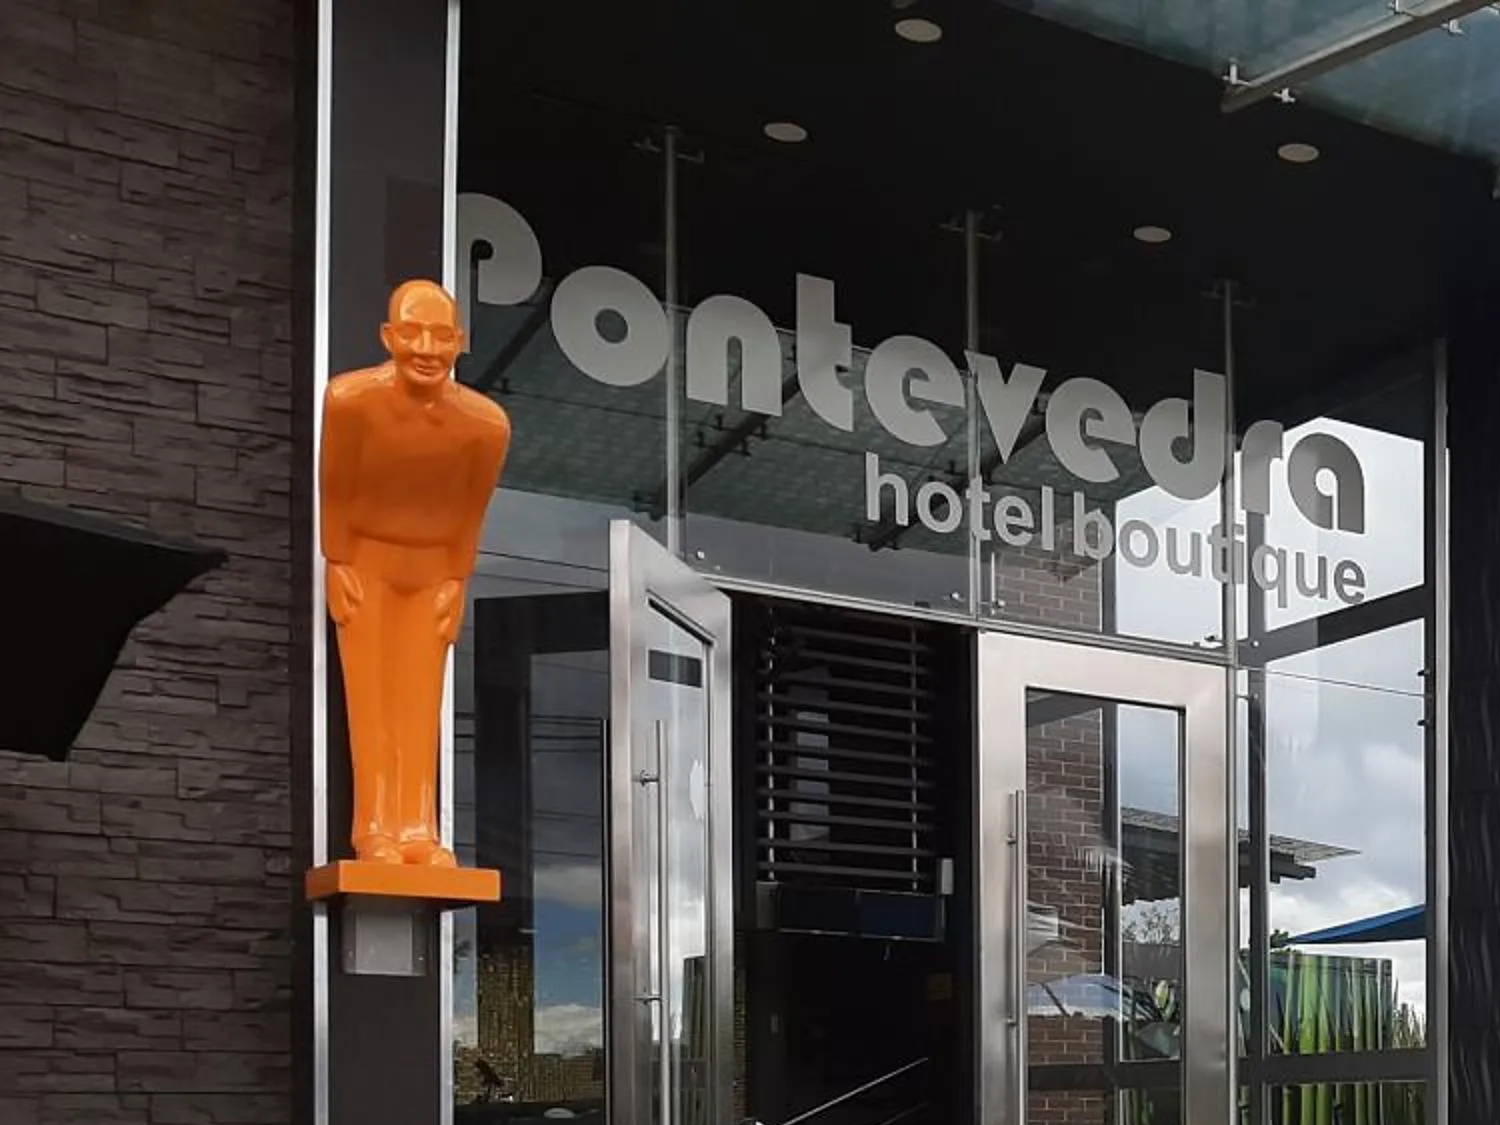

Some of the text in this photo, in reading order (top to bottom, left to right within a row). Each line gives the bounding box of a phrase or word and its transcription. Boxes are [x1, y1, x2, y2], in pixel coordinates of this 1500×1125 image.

[457, 193, 1365, 534] Pontevedra
[865, 452, 1366, 609] hotel boutique
